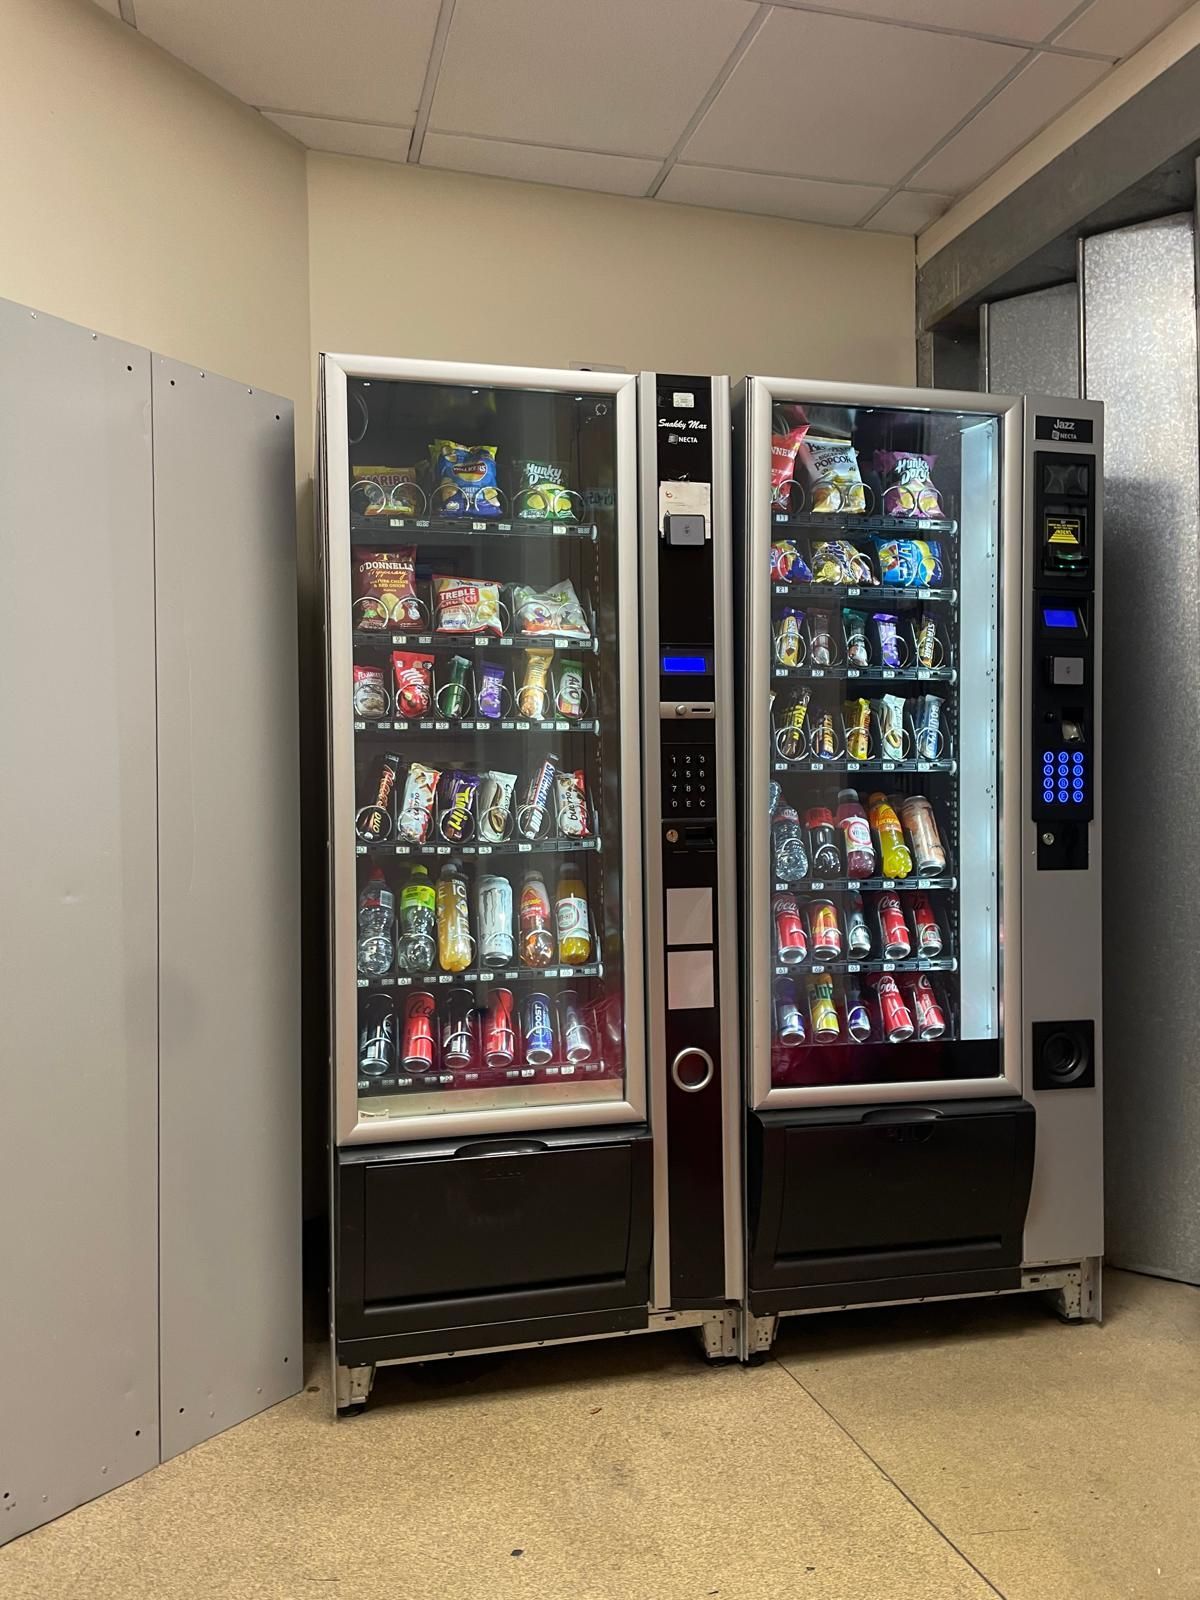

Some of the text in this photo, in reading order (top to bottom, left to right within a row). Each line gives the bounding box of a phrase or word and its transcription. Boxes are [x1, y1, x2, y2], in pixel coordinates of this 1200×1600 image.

[1054, 419, 1076, 430] Jazz
[524, 463, 562, 480] Hunky
[440, 588, 476, 600] TREBLE
[448, 786, 471, 831] Twirl
[372, 812, 382, 834] DUO
